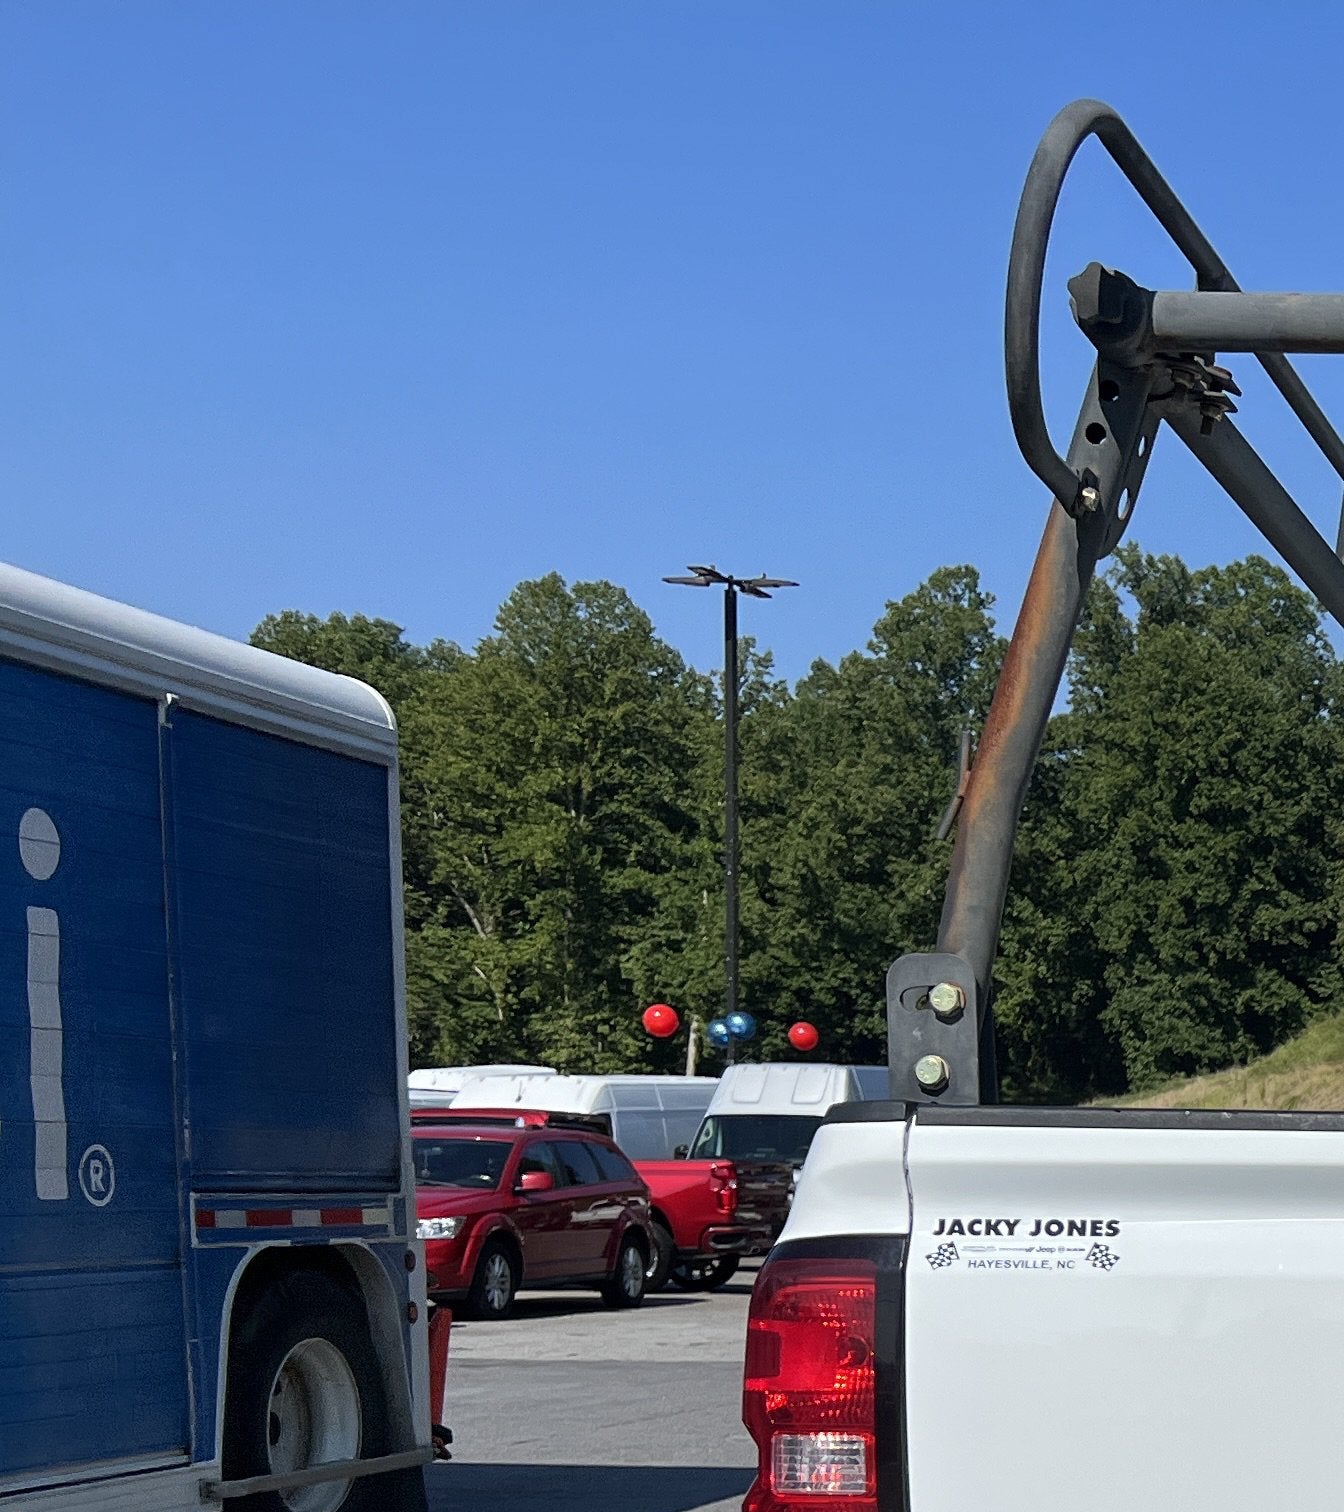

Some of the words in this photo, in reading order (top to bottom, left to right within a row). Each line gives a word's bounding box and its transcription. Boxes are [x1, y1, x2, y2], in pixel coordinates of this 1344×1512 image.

[932, 1218, 1021, 1237] JACKY
[1029, 1219, 1121, 1238] JONES
[967, 1259, 1053, 1271] HAYESVILLE,
[1056, 1259, 1076, 1269] NC
